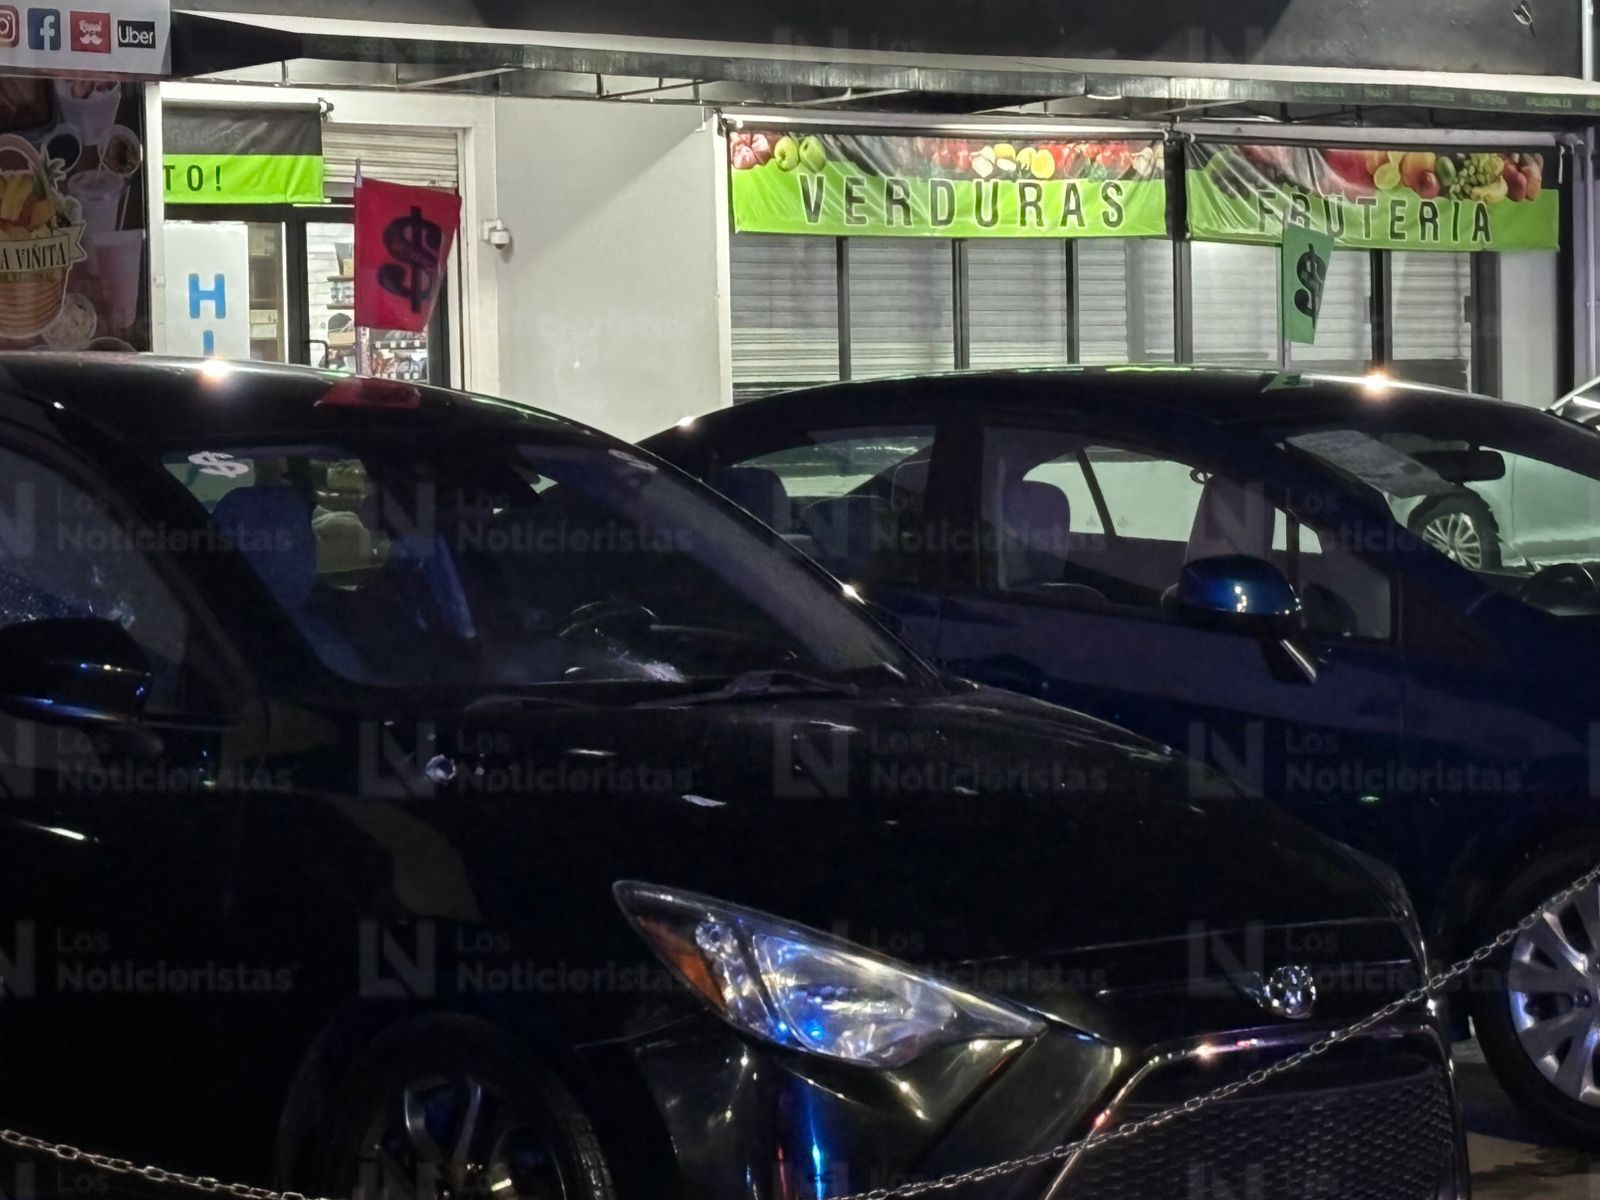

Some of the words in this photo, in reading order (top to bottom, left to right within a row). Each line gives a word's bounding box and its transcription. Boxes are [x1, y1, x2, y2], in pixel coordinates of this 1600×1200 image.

[118, 24, 154, 44] Uber
[163, 164, 222, 192] TO!
[798, 174, 1126, 229] VERDURAS
[1255, 189, 1494, 244] FRUTERIA
[15, 242, 67, 270] VIÑITA
[377, 206, 443, 314] $
[1293, 243, 1326, 329] $
